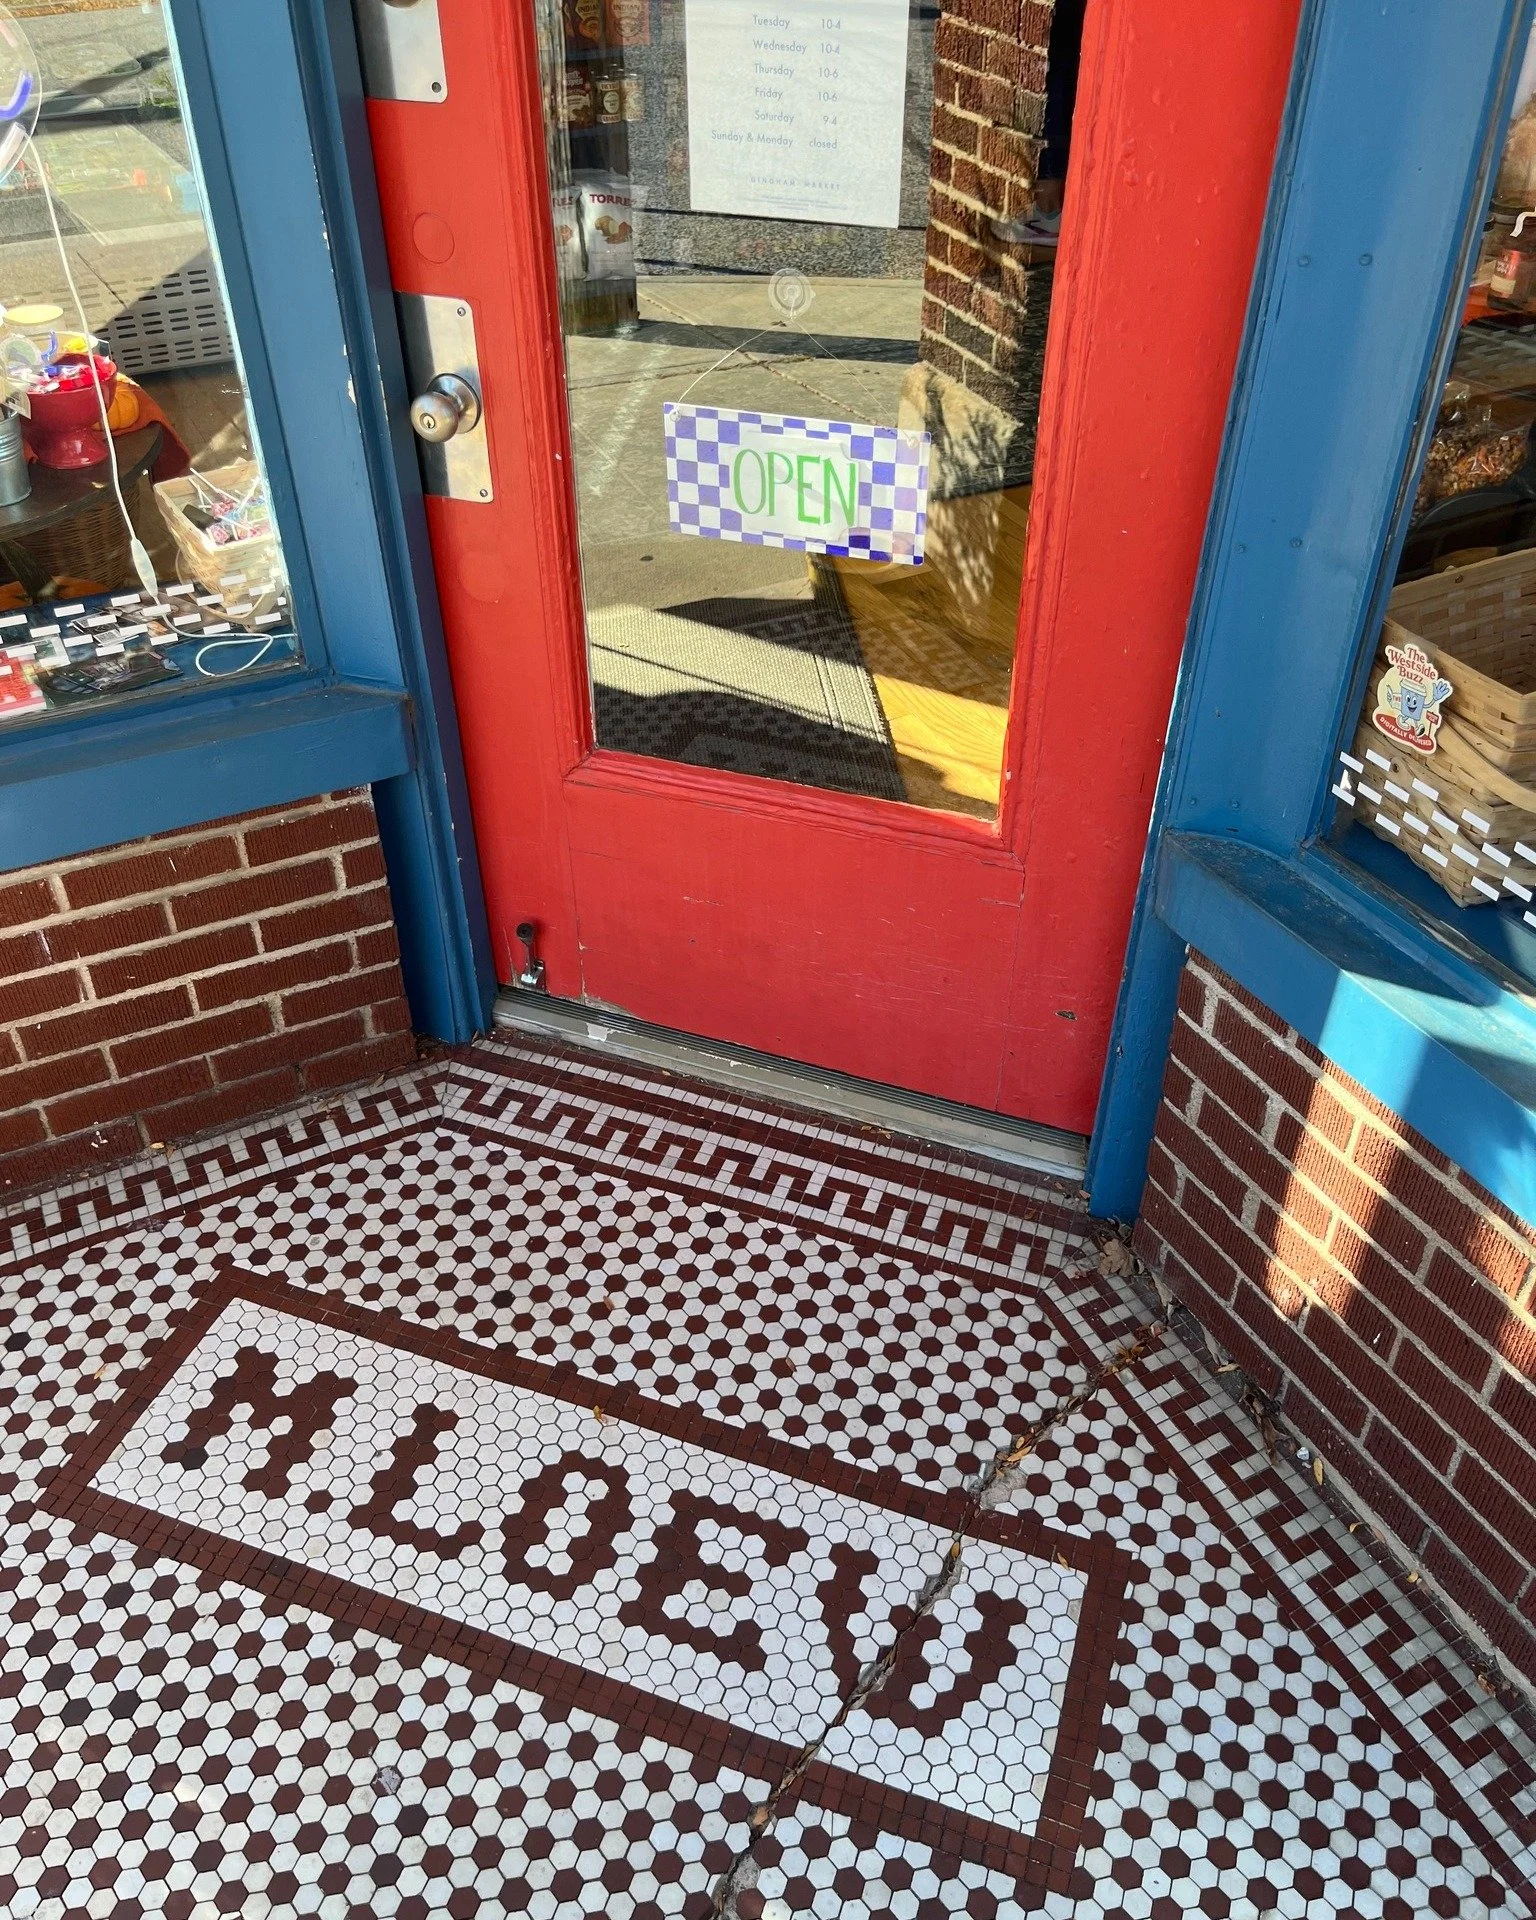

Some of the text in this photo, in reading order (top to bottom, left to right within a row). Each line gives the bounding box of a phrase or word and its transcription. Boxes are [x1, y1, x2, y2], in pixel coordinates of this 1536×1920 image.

[753, 15, 842, 30] Tuesday 10-4
[753, 40, 841, 55] Wednesday 10-4
[754, 63, 839, 79] Thursday 10-6
[755, 87, 838, 102] Friday 10-6
[754, 110, 795, 125] Saturday
[711, 130, 838, 150] Sunday & Monday closed
[804, 181, 841, 191] MARKET
[733, 448, 856, 527] OPEN
[1407, 647, 1425, 663] The
[1387, 648, 1437, 680] Westside
[1397, 665, 1425, 685] Buzz
[1379, 716, 1409, 738] DIGITALLY
